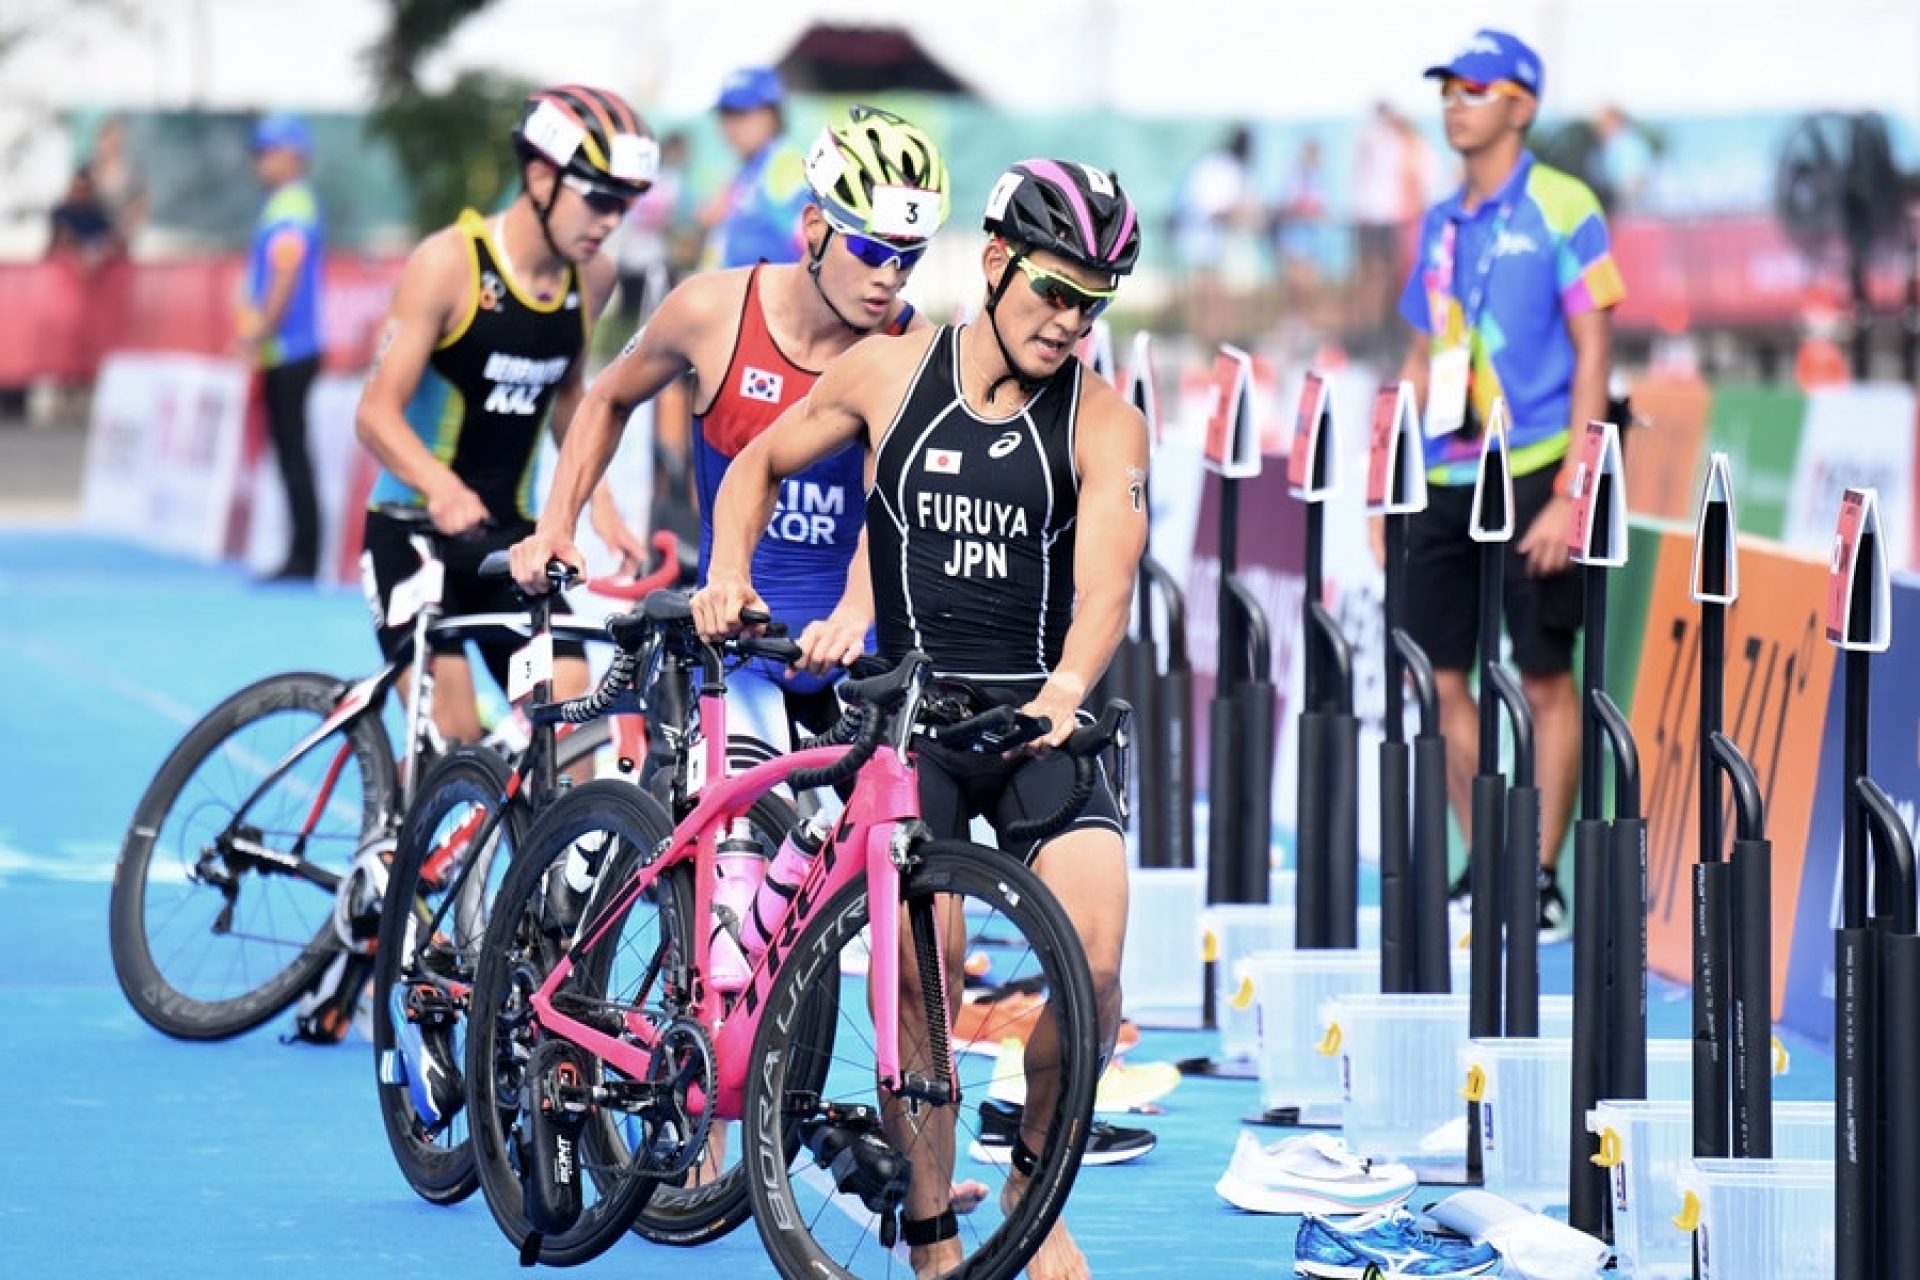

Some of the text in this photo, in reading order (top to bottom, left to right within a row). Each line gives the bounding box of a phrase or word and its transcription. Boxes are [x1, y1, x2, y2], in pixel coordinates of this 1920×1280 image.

[905, 202, 919, 225] 3
[484, 384, 542, 416] KAZ
[776, 478, 845, 515] IM
[916, 491, 1029, 539] FURUYA
[944, 539, 1008, 579] JPN
[759, 890, 867, 1230] BORA ULTR
